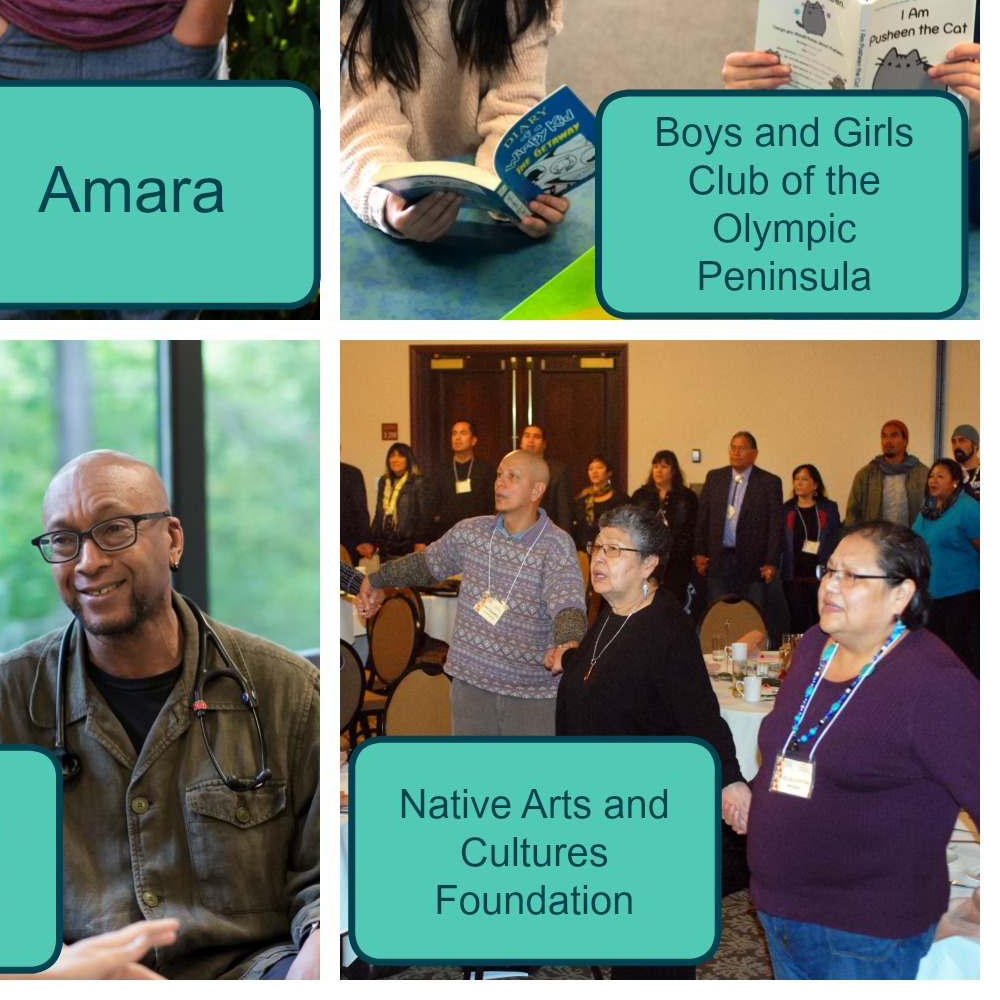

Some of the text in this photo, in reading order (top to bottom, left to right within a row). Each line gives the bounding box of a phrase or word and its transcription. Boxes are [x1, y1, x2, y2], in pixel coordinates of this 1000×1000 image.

[908, 7, 930, 20] Am
[869, 22, 968, 47] Pusheen the Cat
[503, 106, 546, 149] DIARY
[533, 122, 580, 158] GETAWAY
